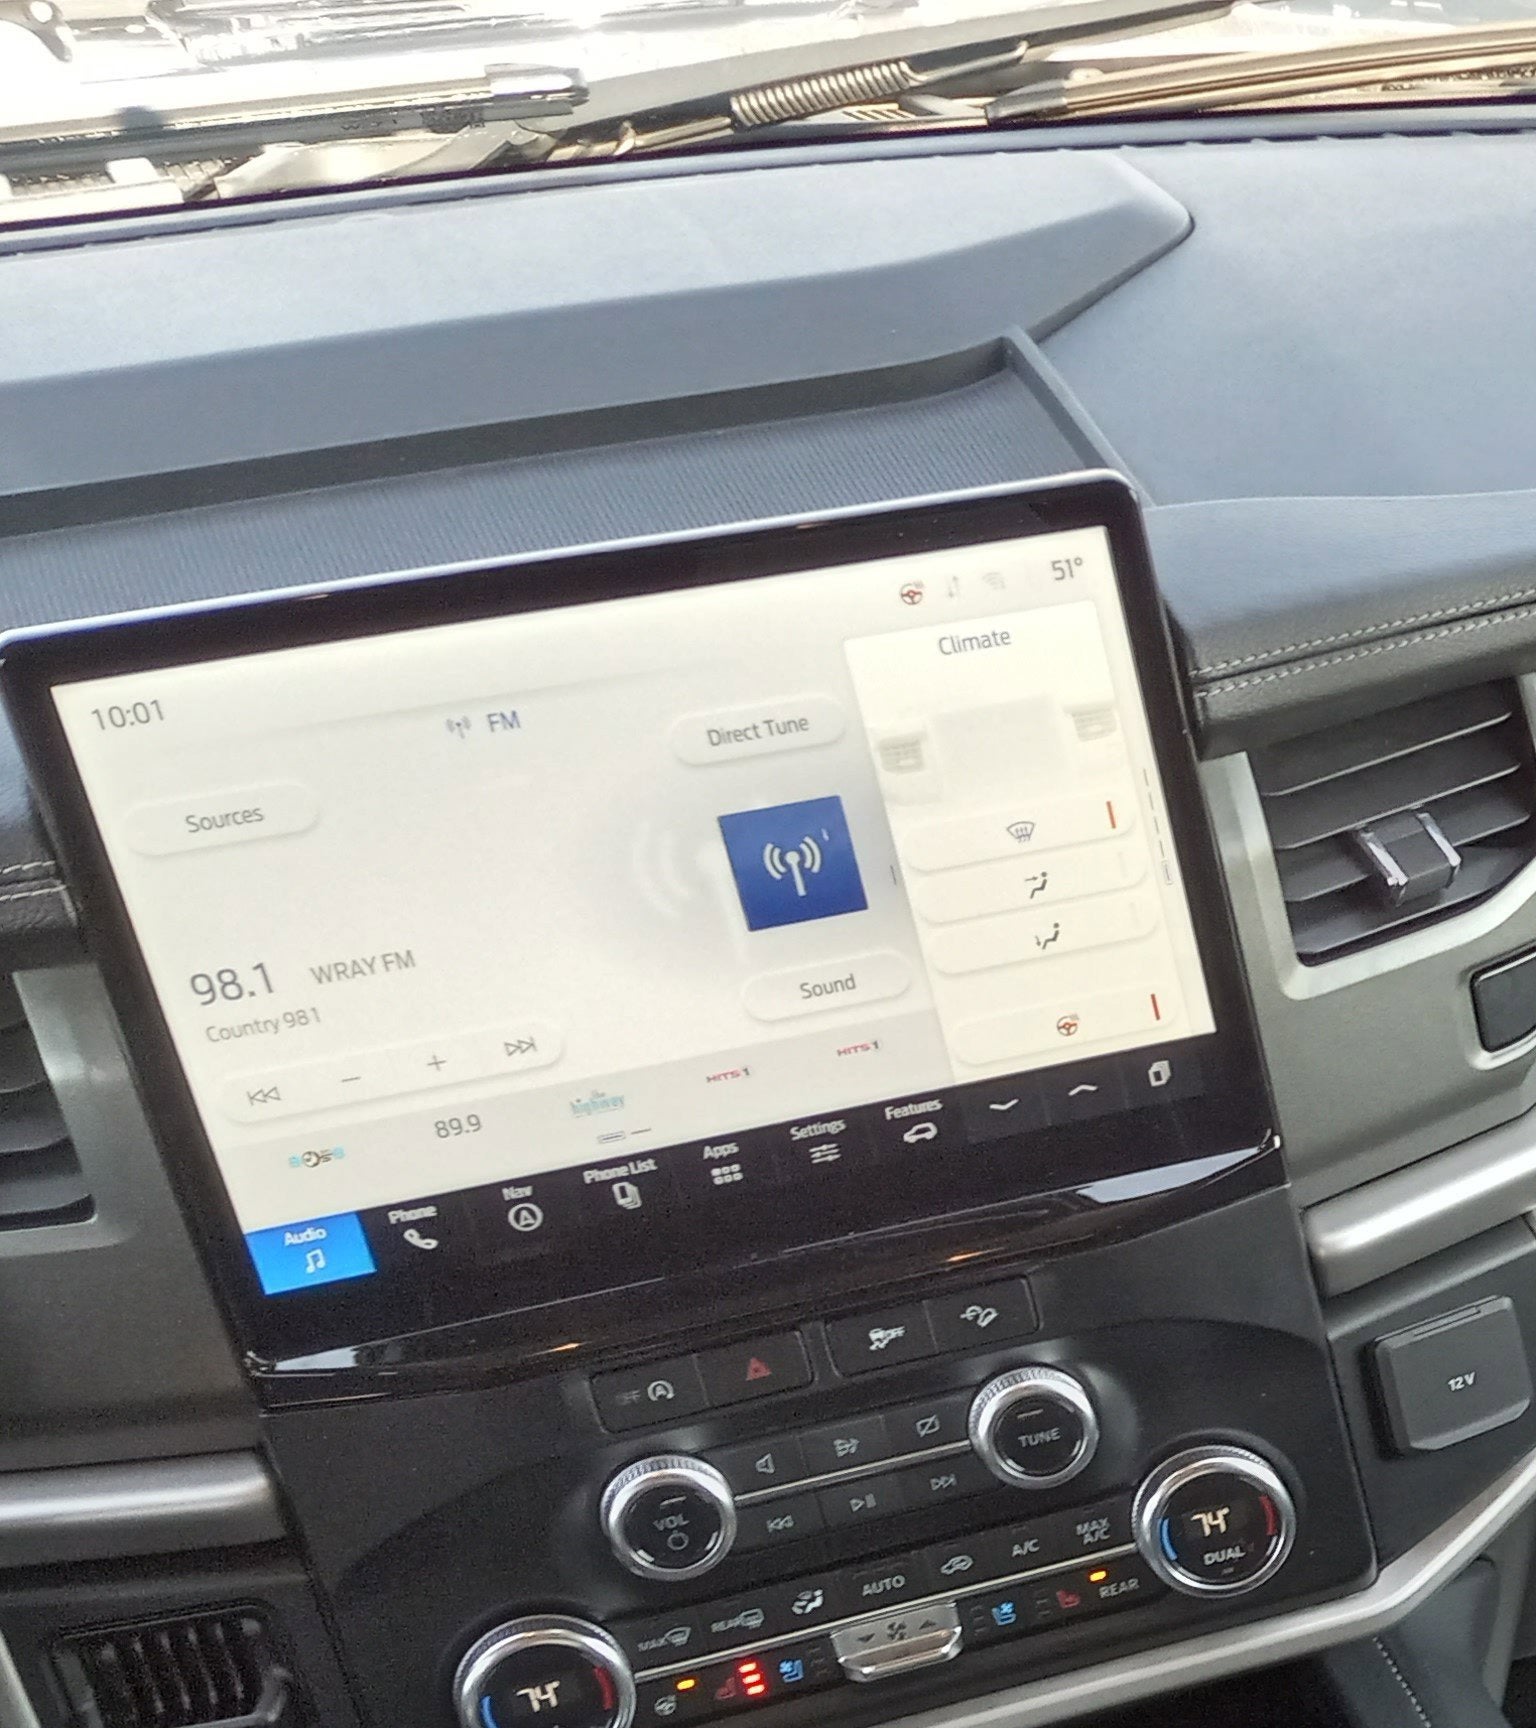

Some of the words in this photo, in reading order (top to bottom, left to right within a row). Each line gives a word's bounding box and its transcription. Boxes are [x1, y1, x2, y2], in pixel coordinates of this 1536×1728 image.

[1051, 557, 1083, 581] 51°
[938, 628, 1012, 657] Climate
[92, 699, 165, 733] 10:01
[486, 710, 521, 734] FM
[707, 718, 760, 748] Direct
[763, 713, 810, 738] Tune
[186, 804, 265, 834] Sources
[190, 962, 275, 1006] 98.1
[310, 955, 377, 985] WRAY
[381, 950, 416, 972] FM
[800, 973, 856, 1001] Sound
[205, 1016, 280, 1043] Country
[884, 1099, 943, 1121] Features
[434, 1113, 482, 1140] 89.9
[789, 1119, 847, 1141] Settings
[702, 1142, 740, 1161] Apps
[583, 1161, 628, 1184] Phone
[629, 1157, 658, 1175] List
[502, 1184, 533, 1201] Nav
[388, 1204, 438, 1225] Phone
[283, 1225, 328, 1247] Audio
[1447, 1371, 1475, 1391] 12V
[1018, 1427, 1061, 1448] TUNE
[652, 1513, 690, 1531] VOL
[1076, 1517, 1110, 1536] MAX
[1012, 1538, 1040, 1557] A/C
[1083, 1528, 1110, 1545] A/C
[1203, 1545, 1246, 1566] DUAL
[861, 1575, 905, 1596] AUTO
[1099, 1577, 1139, 1598] REAR
